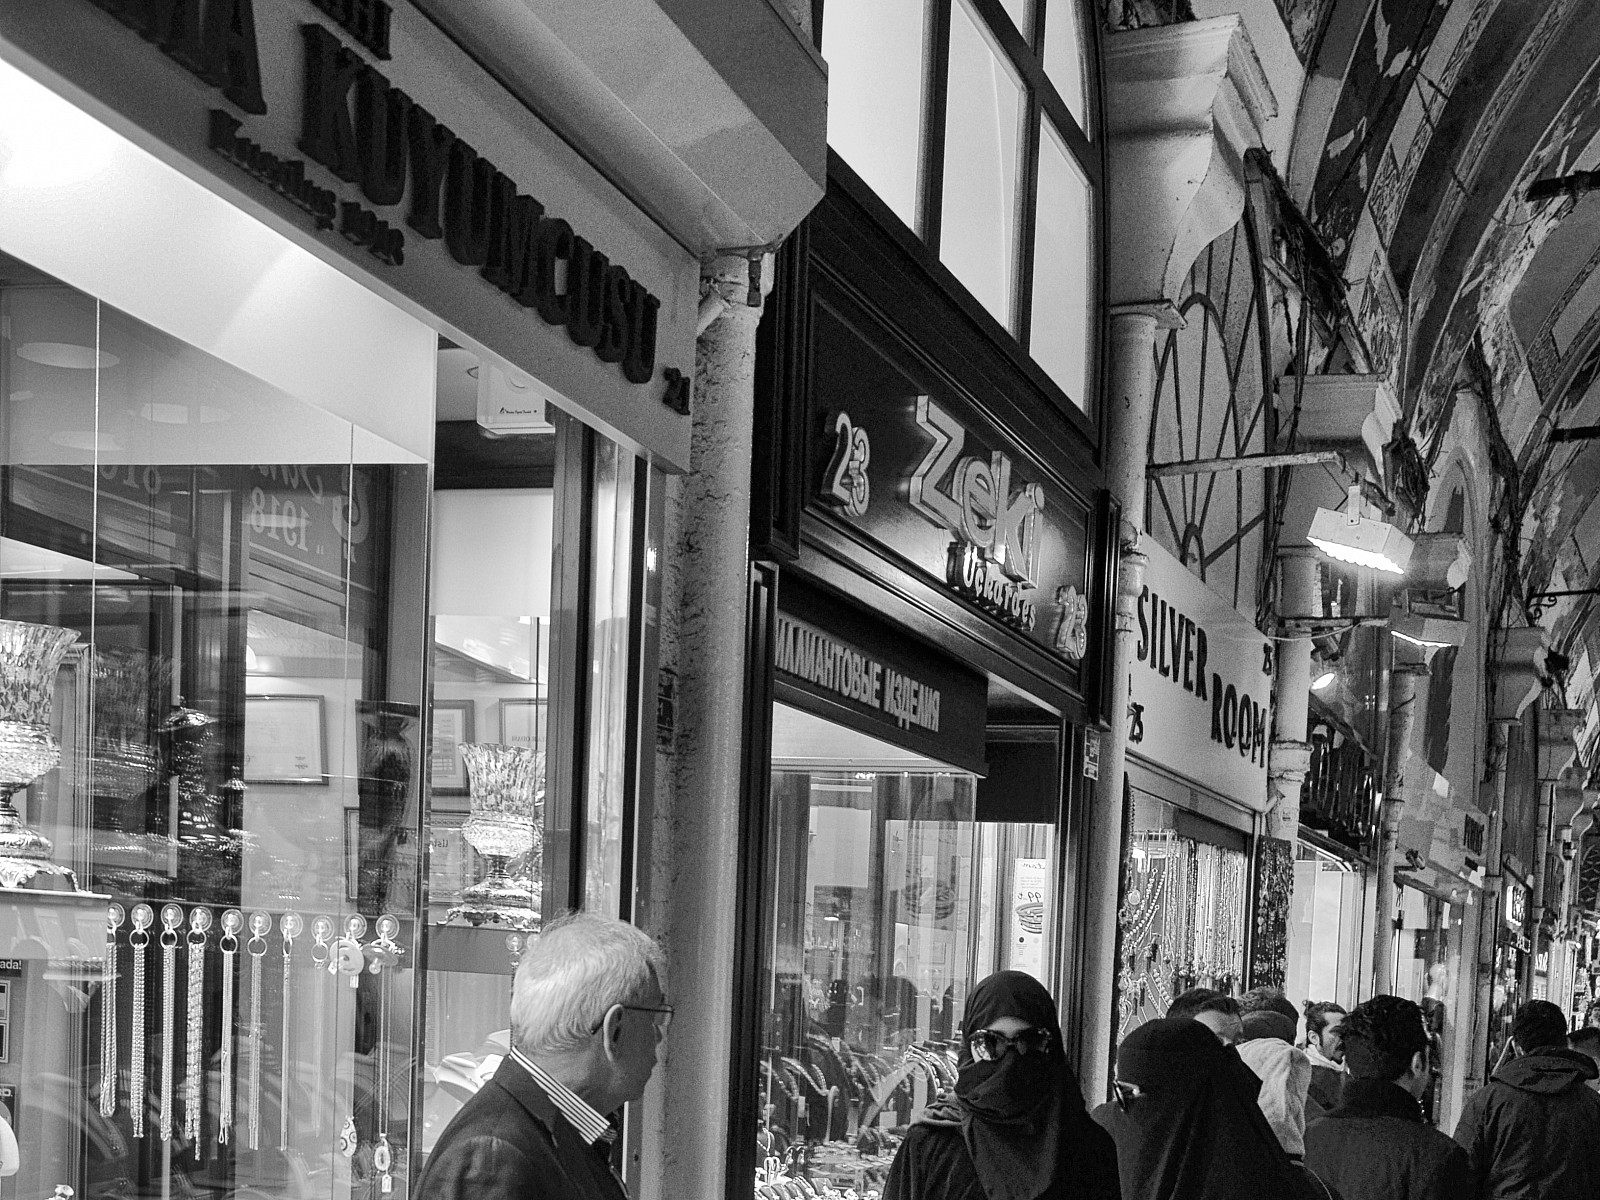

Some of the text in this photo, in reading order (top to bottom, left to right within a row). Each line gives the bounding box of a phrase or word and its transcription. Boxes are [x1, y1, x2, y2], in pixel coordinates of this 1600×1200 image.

[821, 410, 870, 517] 23
[909, 394, 1045, 589] Zeki
[1055, 583, 1088, 660] 23
[1136, 584, 1268, 768] SILVER ROOM
